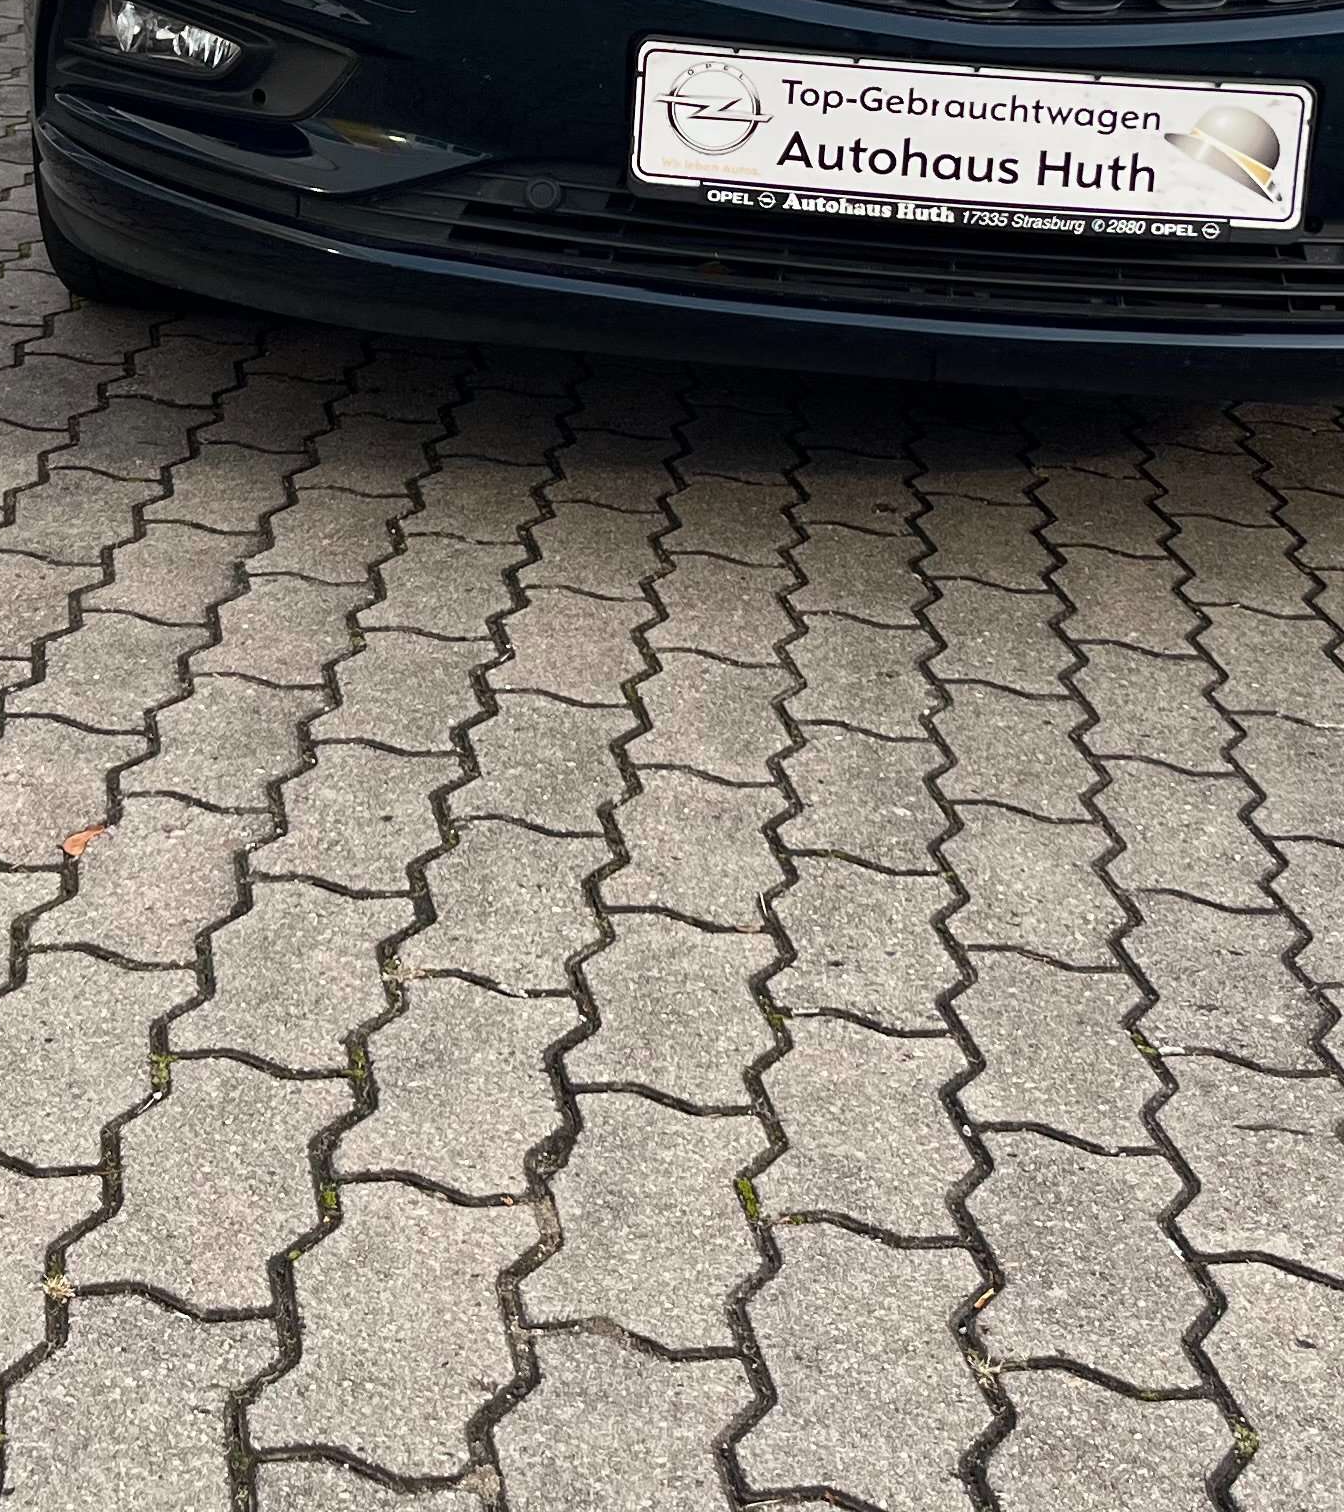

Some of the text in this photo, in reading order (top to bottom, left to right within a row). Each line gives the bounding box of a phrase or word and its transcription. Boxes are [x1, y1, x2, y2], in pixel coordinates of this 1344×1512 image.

[782, 79, 1161, 135] Top-Gebrauchtwagen
[776, 131, 1155, 192] Autohaus Huth
[707, 190, 1199, 237] OPEL Autohaus Huth 17335 Strasburg 2880 OPEL
